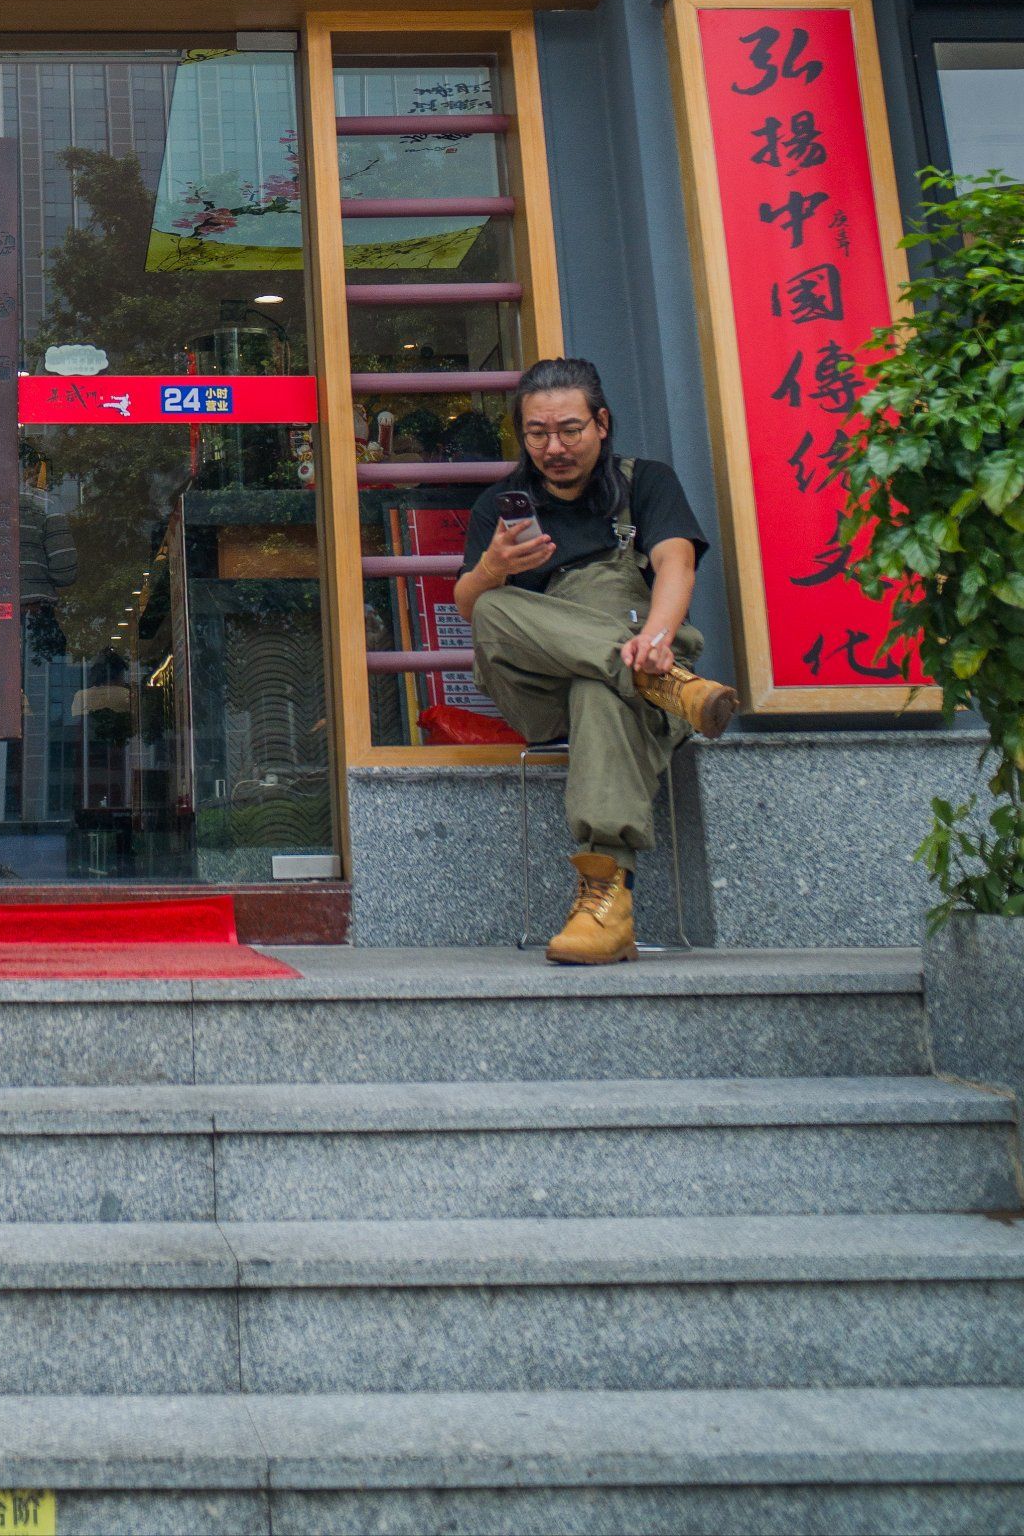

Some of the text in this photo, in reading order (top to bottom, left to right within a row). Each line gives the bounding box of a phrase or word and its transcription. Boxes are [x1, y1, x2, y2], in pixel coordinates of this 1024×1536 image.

[205, 387, 228, 399] 小时
[164, 387, 201, 412] 24
[205, 400, 229, 412] 营业
